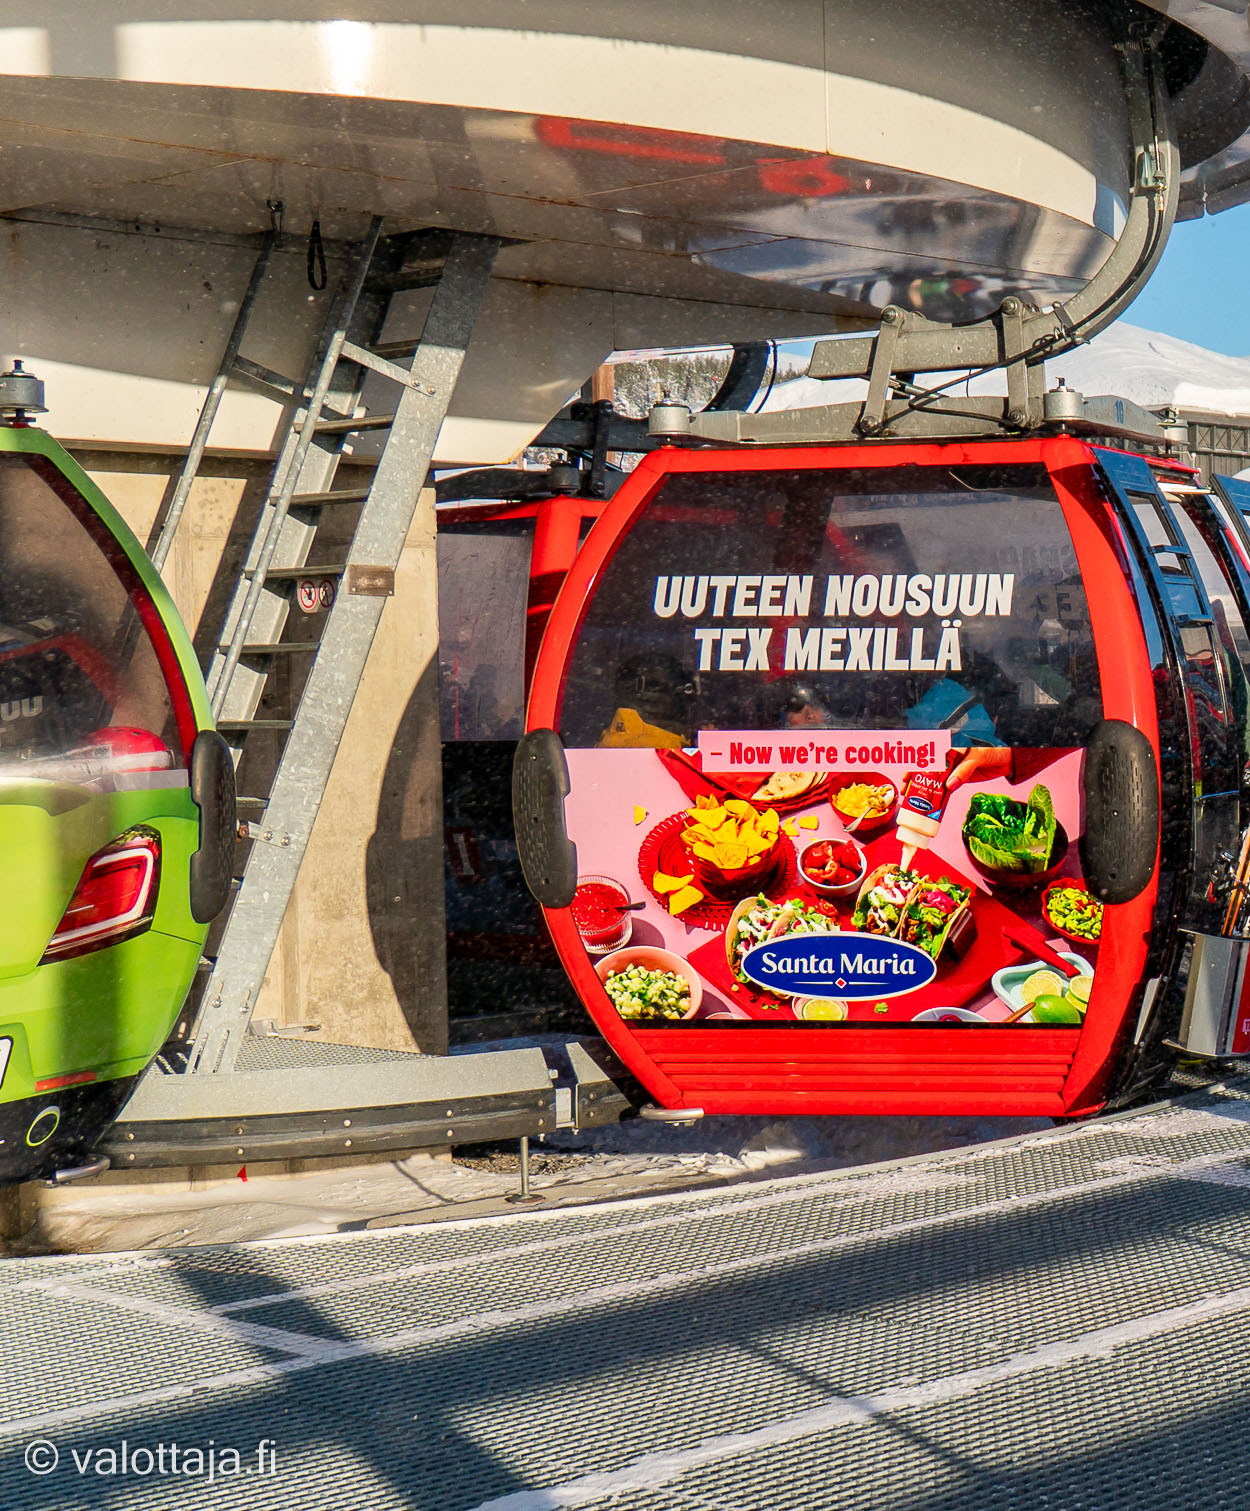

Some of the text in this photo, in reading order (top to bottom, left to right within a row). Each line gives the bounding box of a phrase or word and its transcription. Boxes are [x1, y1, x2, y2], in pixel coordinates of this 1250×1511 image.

[653, 575, 814, 618] UUTEEN
[824, 573, 1015, 617] NOUSUUN
[695, 619, 963, 672] TEX MEXILLÄ
[729, 742, 772, 764] Now
[845, 741, 935, 768] cooking!
[914, 773, 943, 789] MAYO
[761, 951, 917, 975] Santa Maria
